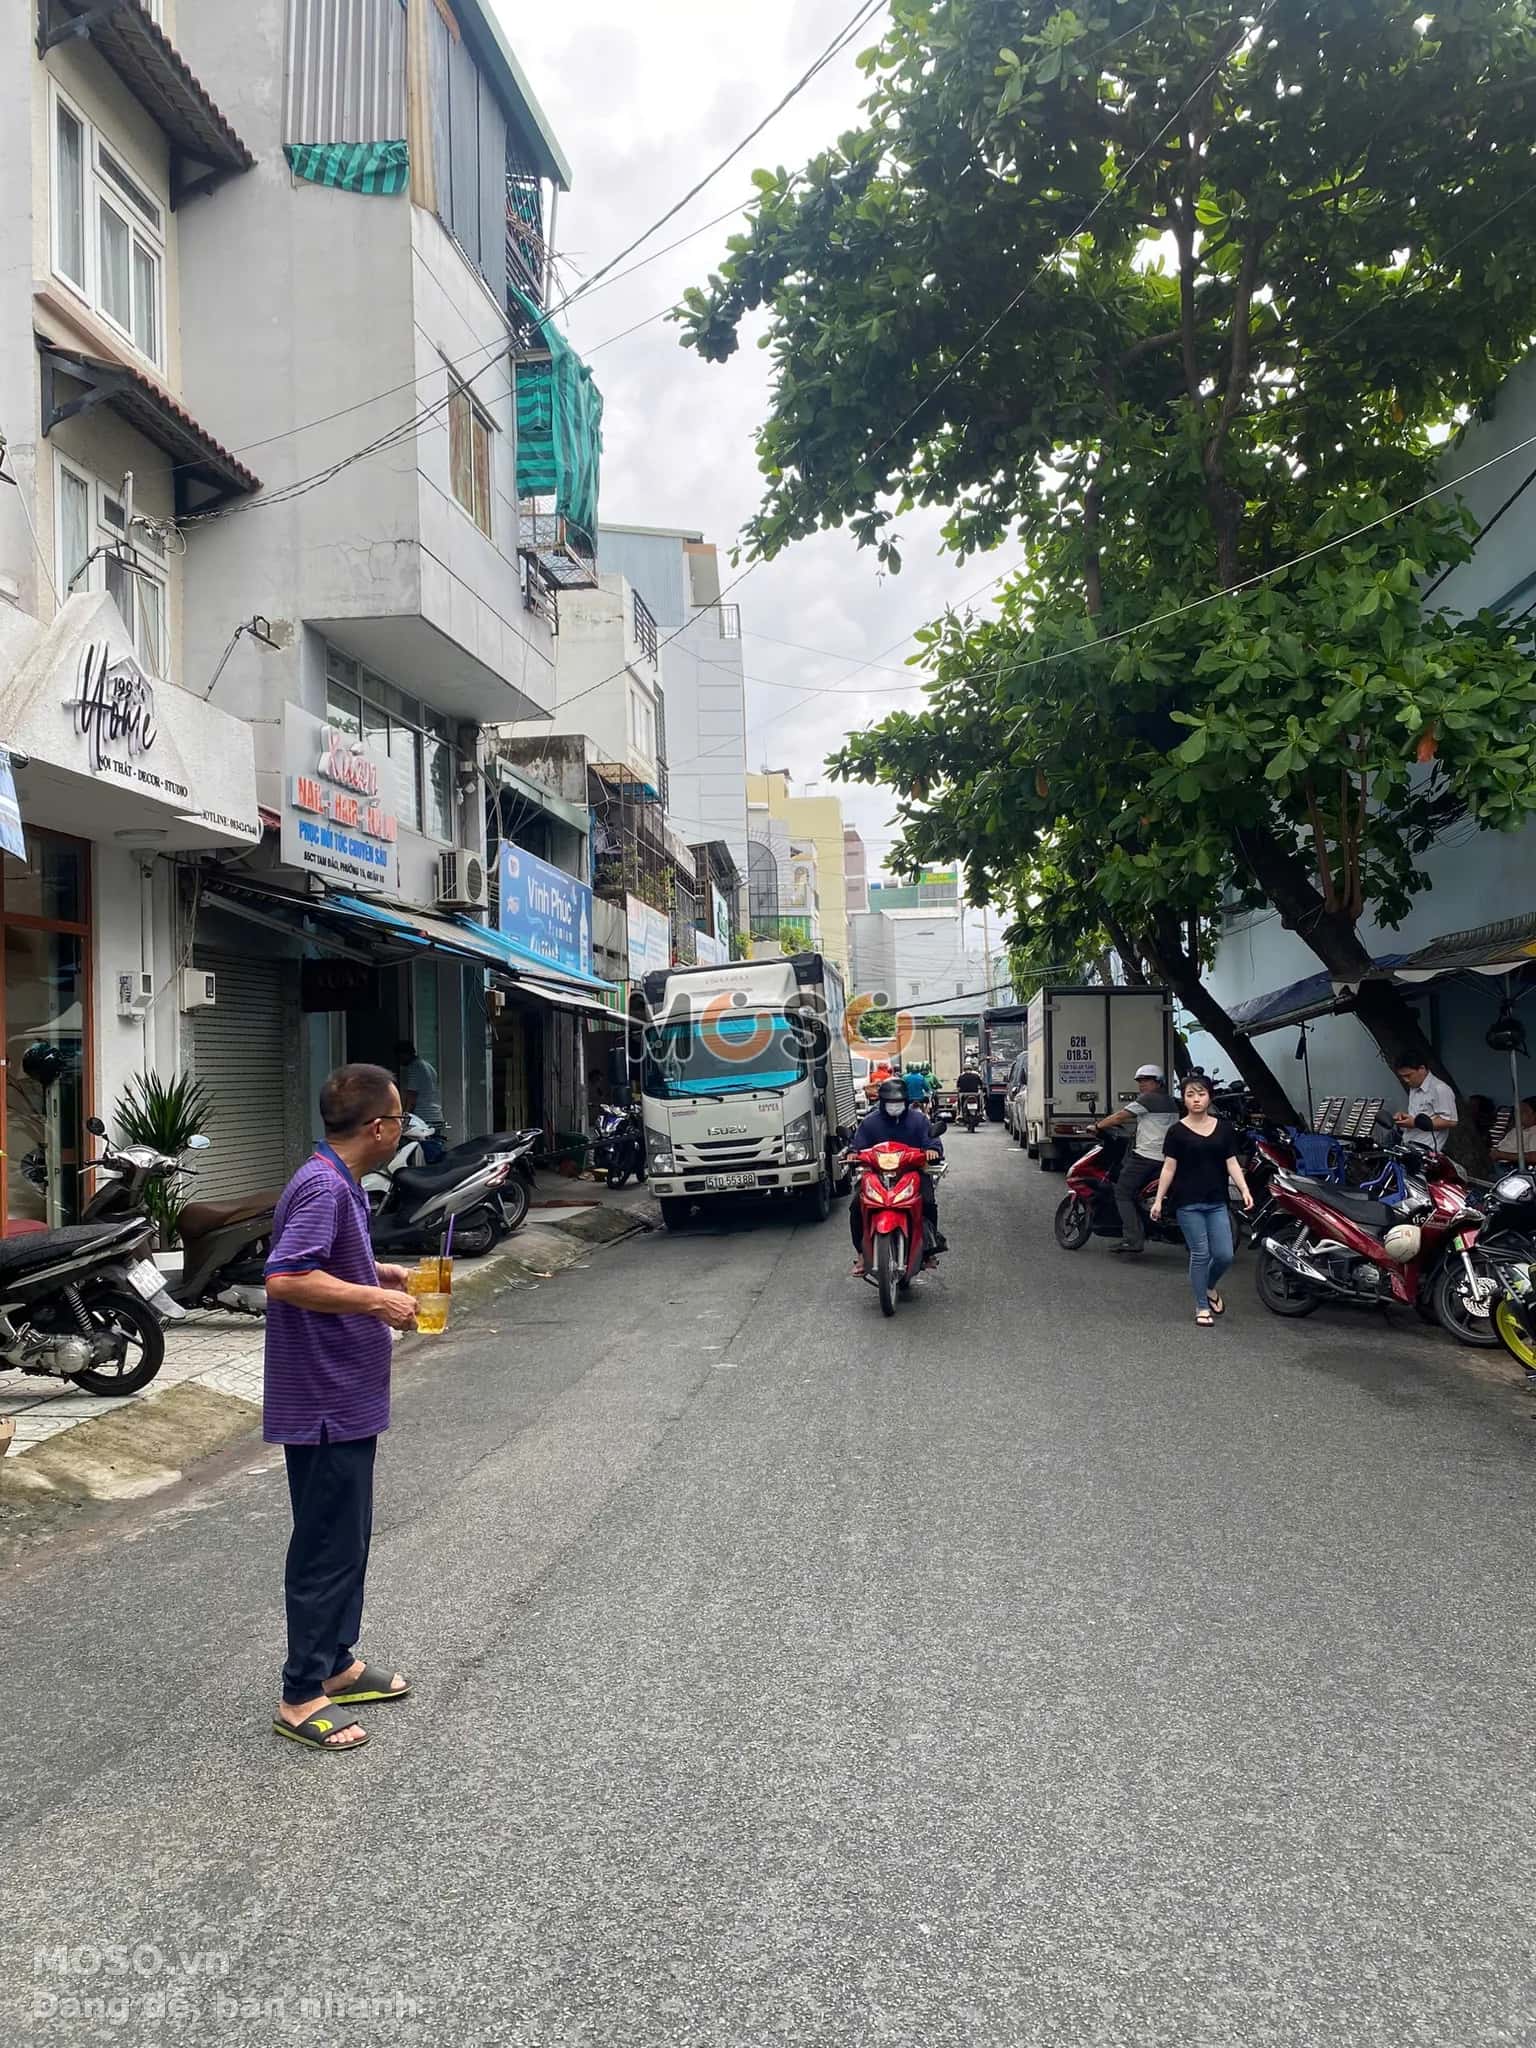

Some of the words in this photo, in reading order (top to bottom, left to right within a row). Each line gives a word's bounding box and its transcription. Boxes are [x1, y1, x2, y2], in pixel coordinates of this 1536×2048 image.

[138, 769, 160, 787] DECOR
[164, 780, 188, 798] STUDIO
[707, 1125, 748, 1136] ISUZU
